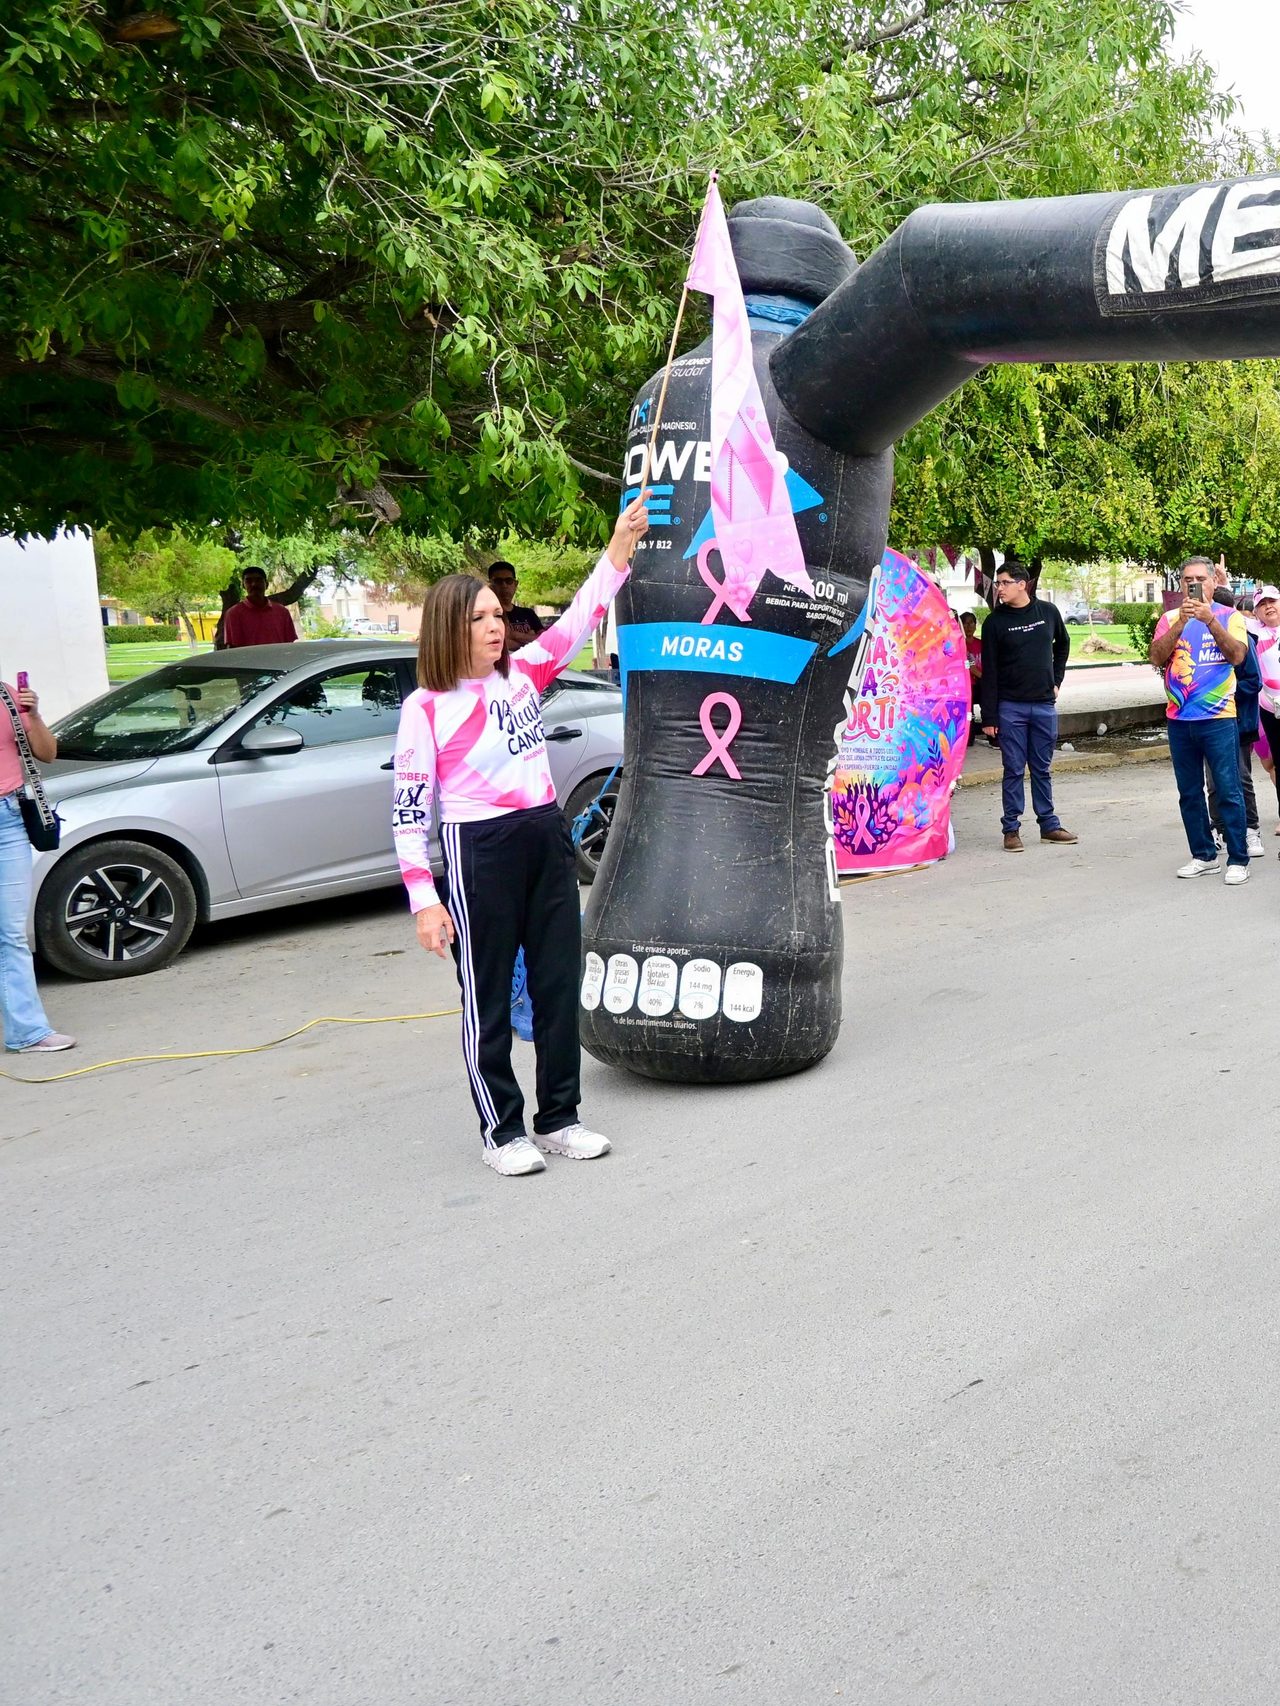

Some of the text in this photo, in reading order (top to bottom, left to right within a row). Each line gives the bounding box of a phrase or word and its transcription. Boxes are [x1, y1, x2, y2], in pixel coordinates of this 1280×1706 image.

[661, 421, 697, 430] MAGNESIO
[649, 541, 655, 549] Y
[656, 540, 672, 549] B12
[813, 581, 835, 600] 00
[765, 597, 790, 607] BEBIDA
[791, 601, 808, 609] PARA
[806, 612, 827, 620] SABOR
[661, 636, 744, 661] MORAS
[632, 944, 690, 957] Este envase aporta:
[693, 964, 711, 973] Sodio
[701, 983, 713, 992] mg
[742, 1004, 755, 1012] kcal
[627, 1017, 635, 1025] los
